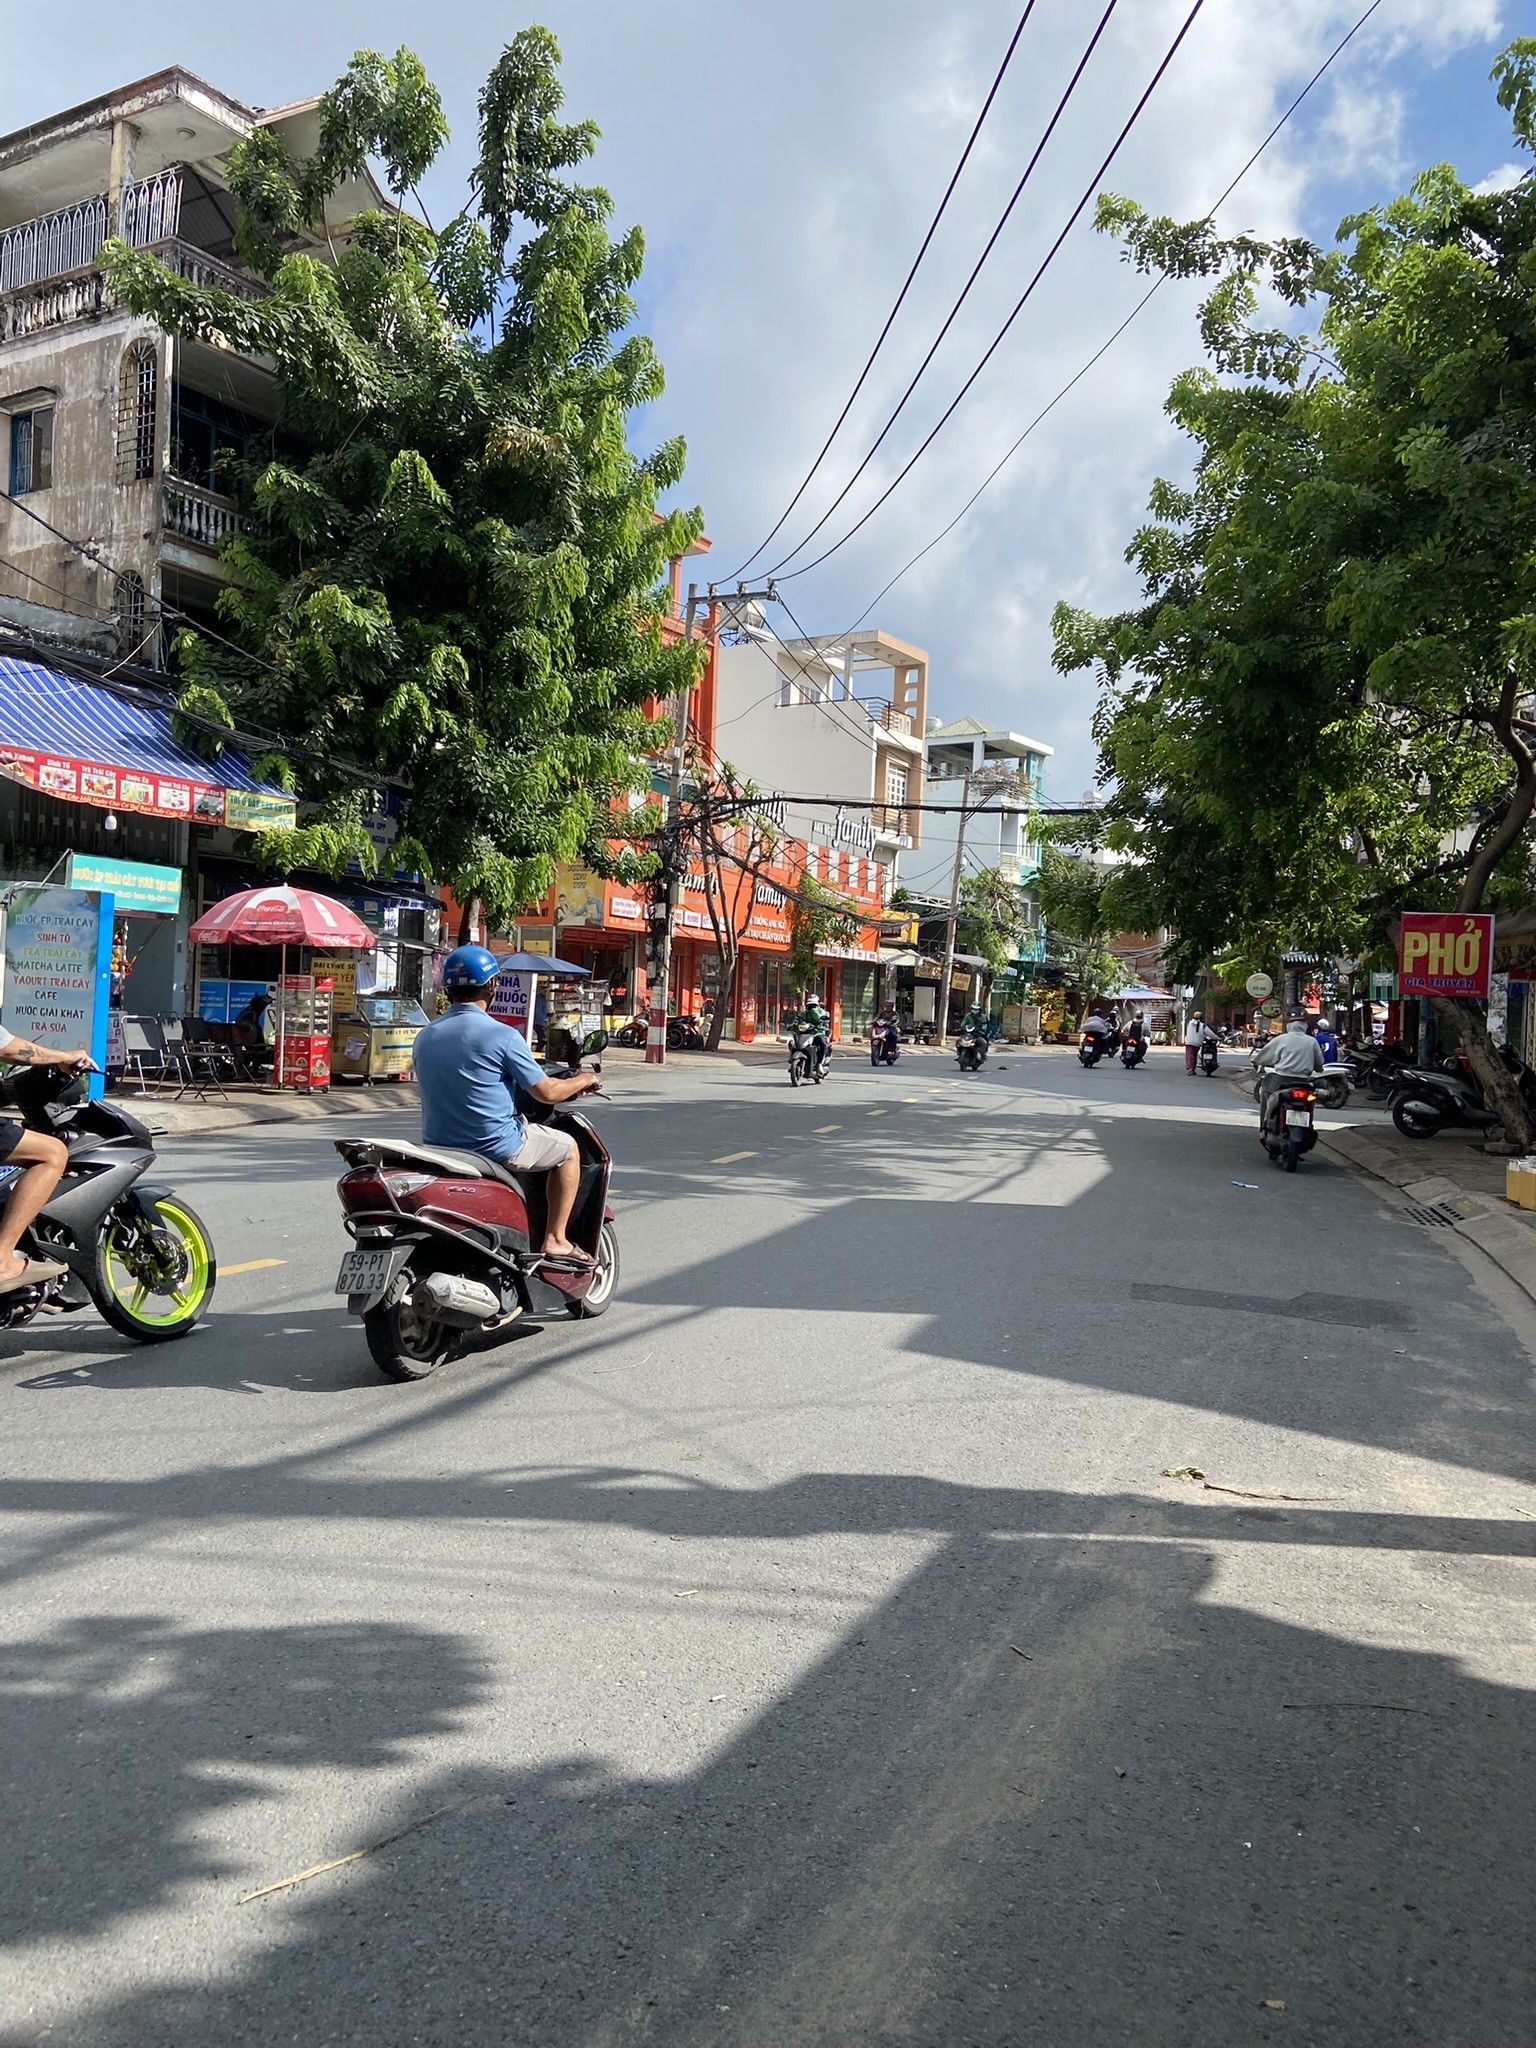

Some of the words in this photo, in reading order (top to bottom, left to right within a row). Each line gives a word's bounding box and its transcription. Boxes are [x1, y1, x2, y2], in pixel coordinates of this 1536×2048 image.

[832, 805, 876, 861] family
[37, 933, 56, 943] SINH
[1403, 918, 1482, 976] PHỞ
[17, 961, 53, 971] MATCHA
[56, 963, 82, 974] LATTE
[14, 975, 47, 987] YAOURT
[498, 974, 520, 988] NHÀ
[1405, 977, 1425, 986] GIA
[35, 990, 57, 1001] CAFE
[495, 989, 528, 1004] HUỐC
[511, 1006, 527, 1016] TUỆ
[349, 1254, 383, 1271] 59-P1
[339, 1274, 385, 1291] 870.33
